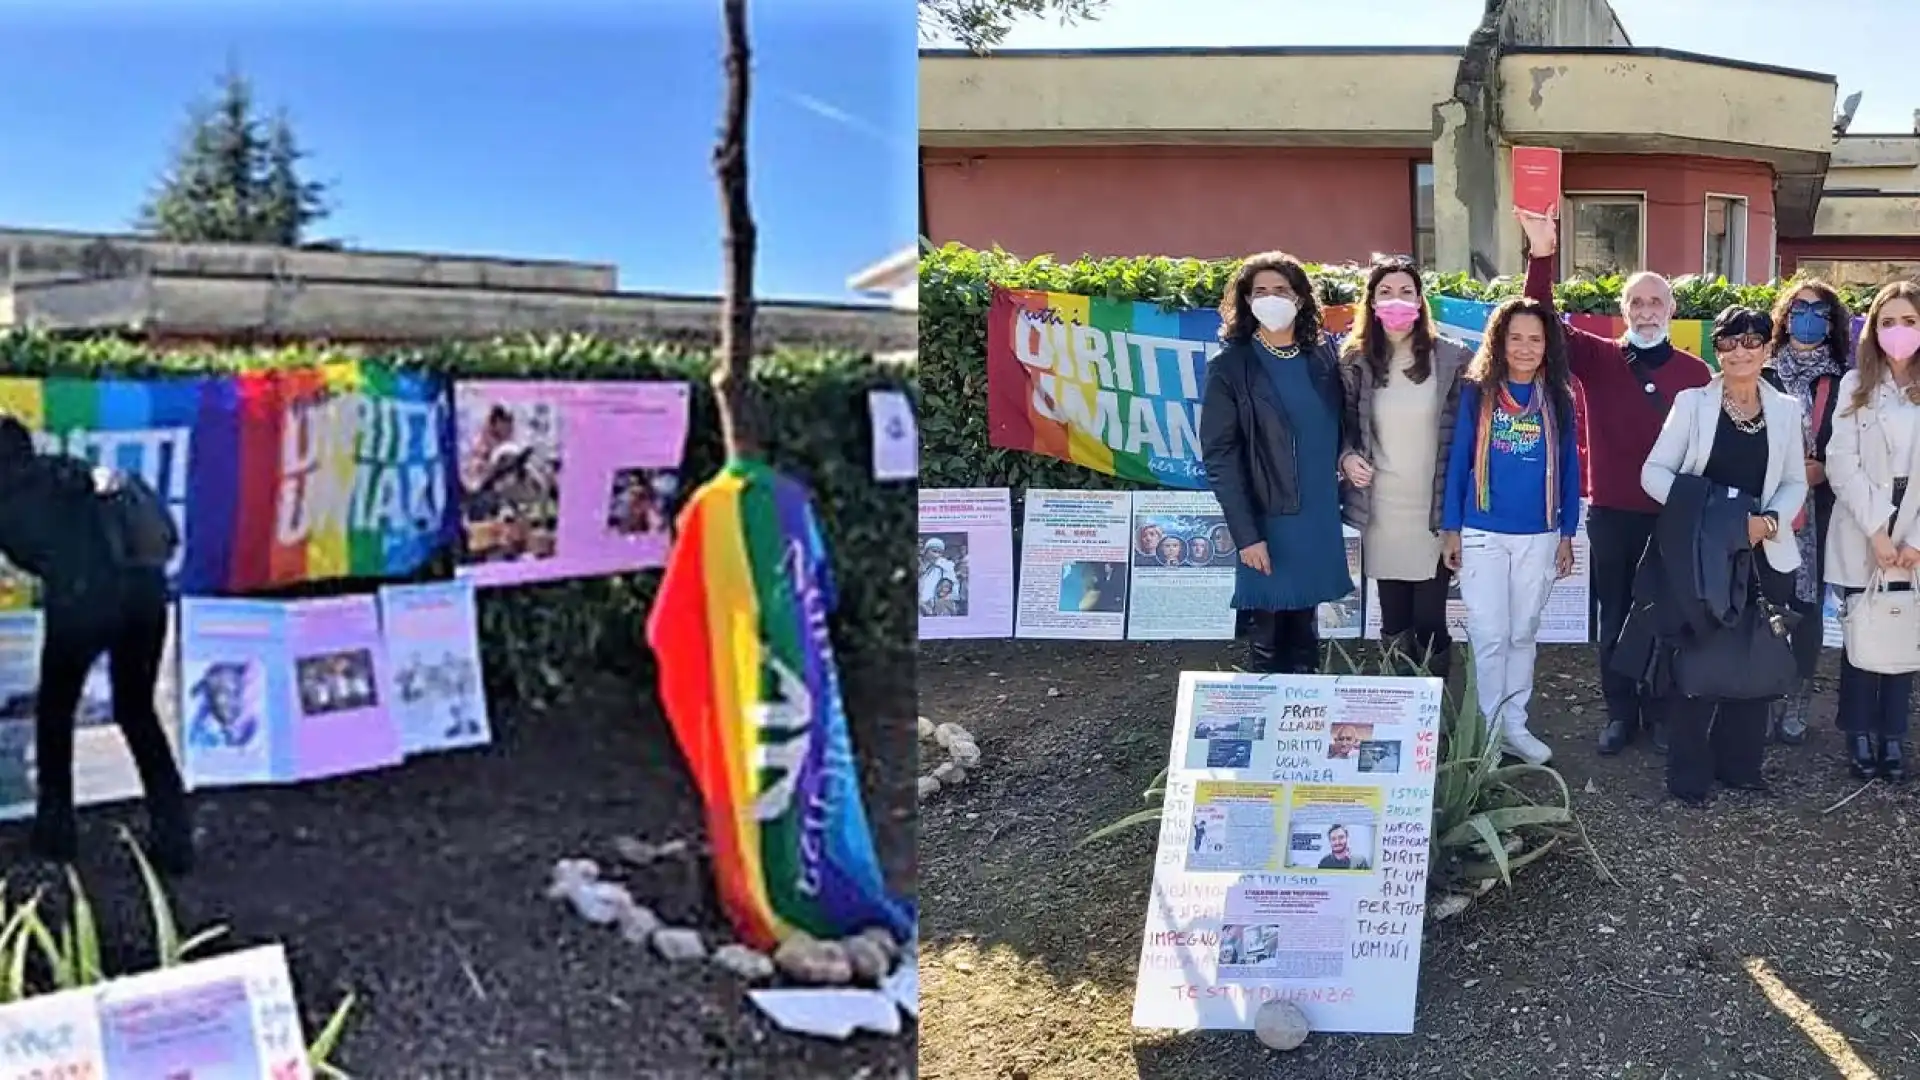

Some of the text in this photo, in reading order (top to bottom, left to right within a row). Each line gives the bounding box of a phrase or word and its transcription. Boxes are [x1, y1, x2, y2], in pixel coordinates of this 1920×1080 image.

[1032, 371, 1203, 462] UMAN
[1281, 704, 1328, 720] FRATE
[1149, 930, 1220, 947] IMPEGNO
[1351, 939, 1409, 961] UOMINI
